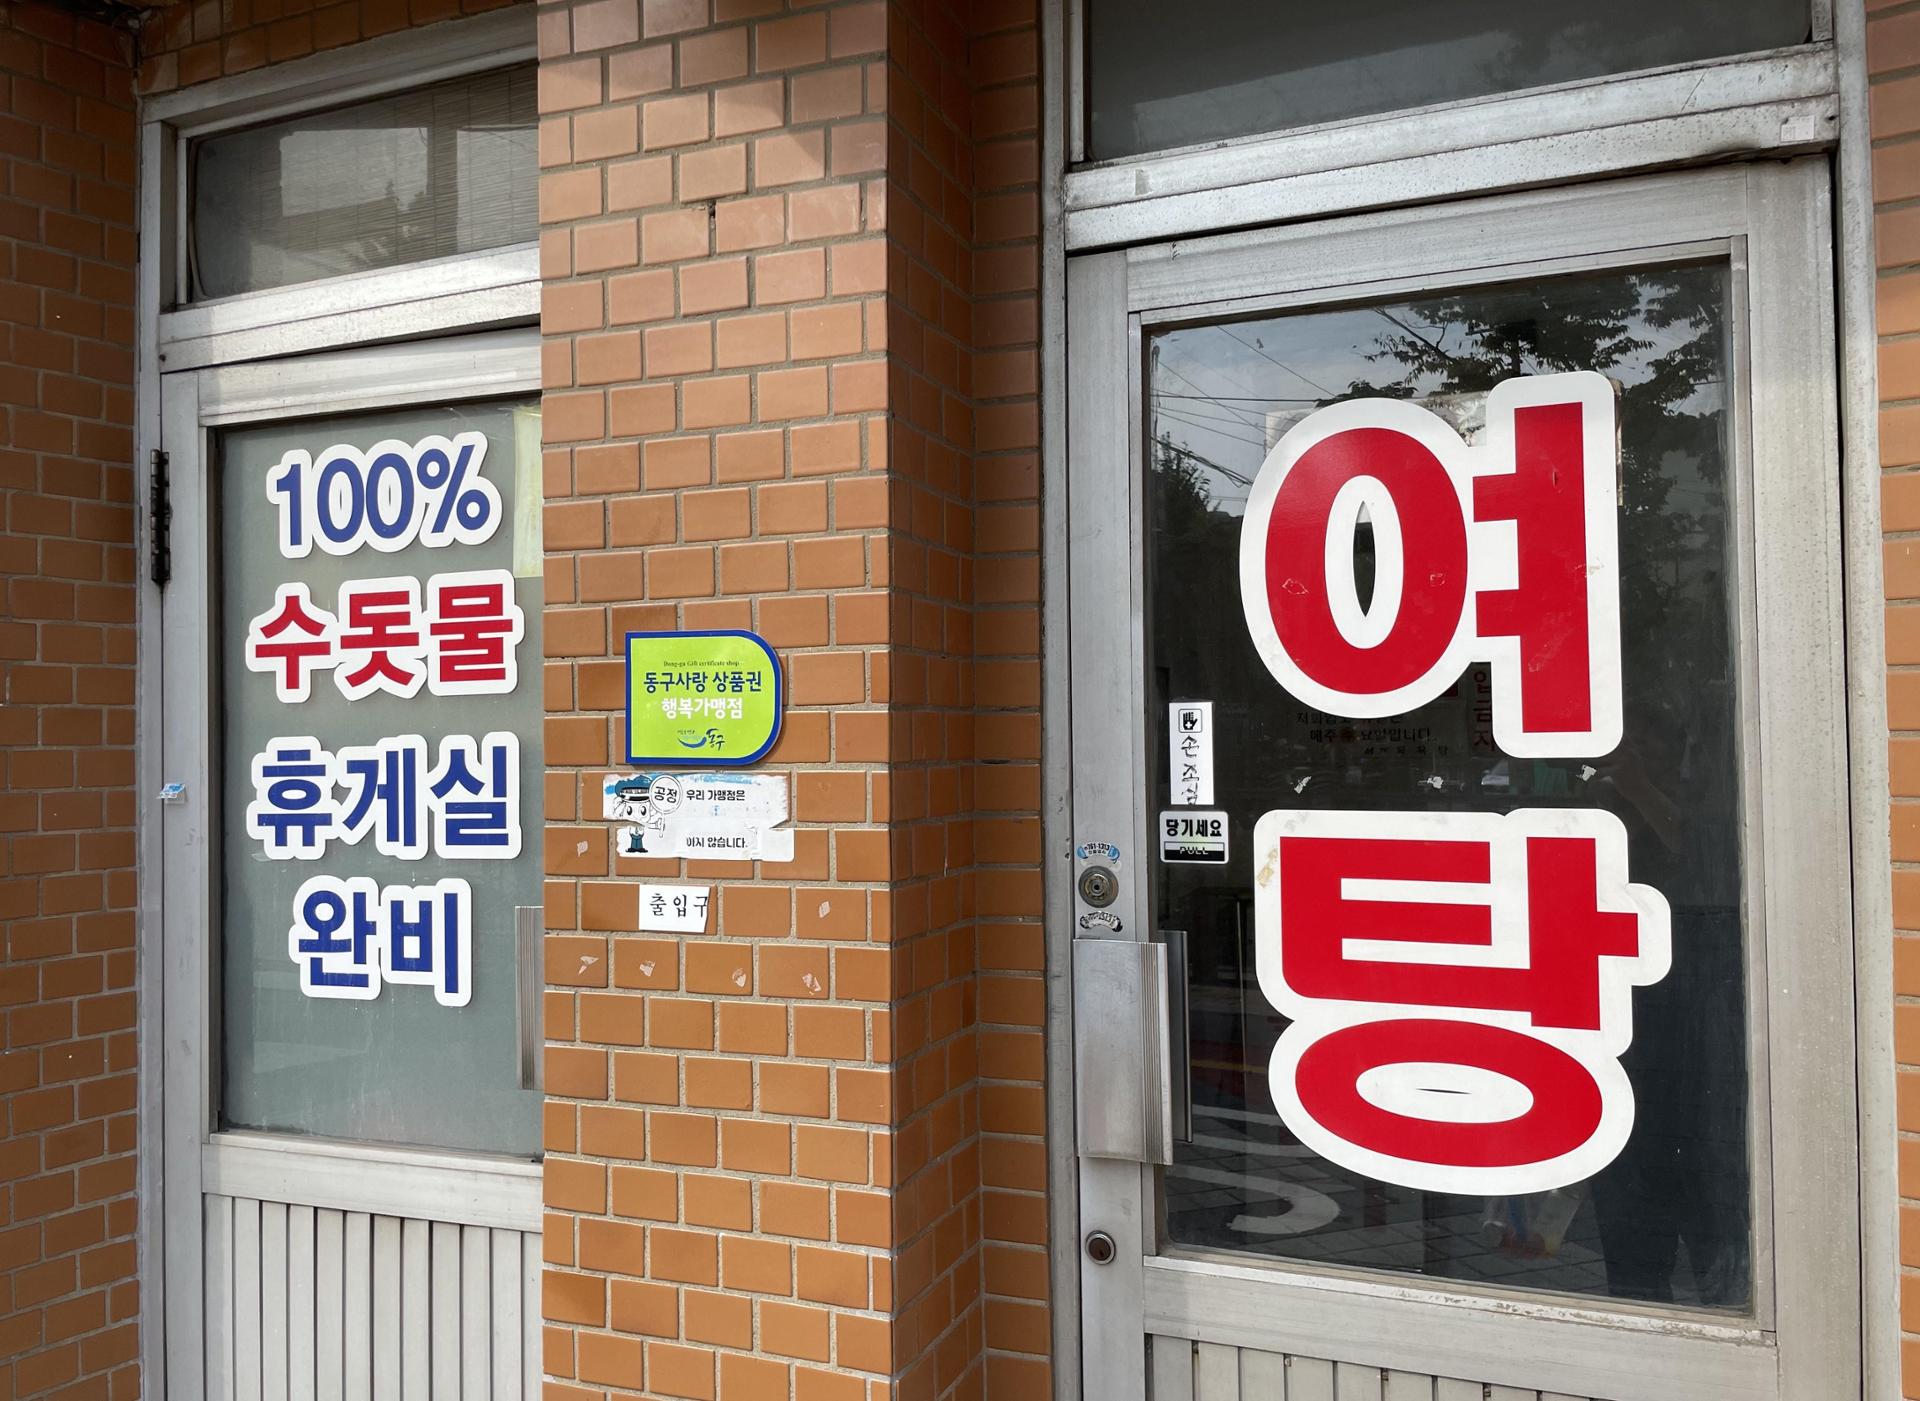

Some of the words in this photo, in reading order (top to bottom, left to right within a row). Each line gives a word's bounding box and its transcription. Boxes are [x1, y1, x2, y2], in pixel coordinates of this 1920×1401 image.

[276, 444, 490, 546] 100%
[255, 583, 513, 690] 수돗물
[643, 672, 708, 693] 동구사랑
[712, 671, 762, 692] 상품권
[661, 697, 743, 720] 행복가맹점
[257, 745, 509, 847] 휴게실
[653, 786, 678, 804] 공정
[686, 789, 705, 801] 우리
[707, 789, 745, 801] 가맹점은
[1266, 402, 1638, 1167] 여탕
[1166, 819, 1222, 838] 당기세요
[707, 837, 749, 849] 않습니다.
[650, 893, 708, 918] 출입구
[298, 889, 458, 994] 완비
